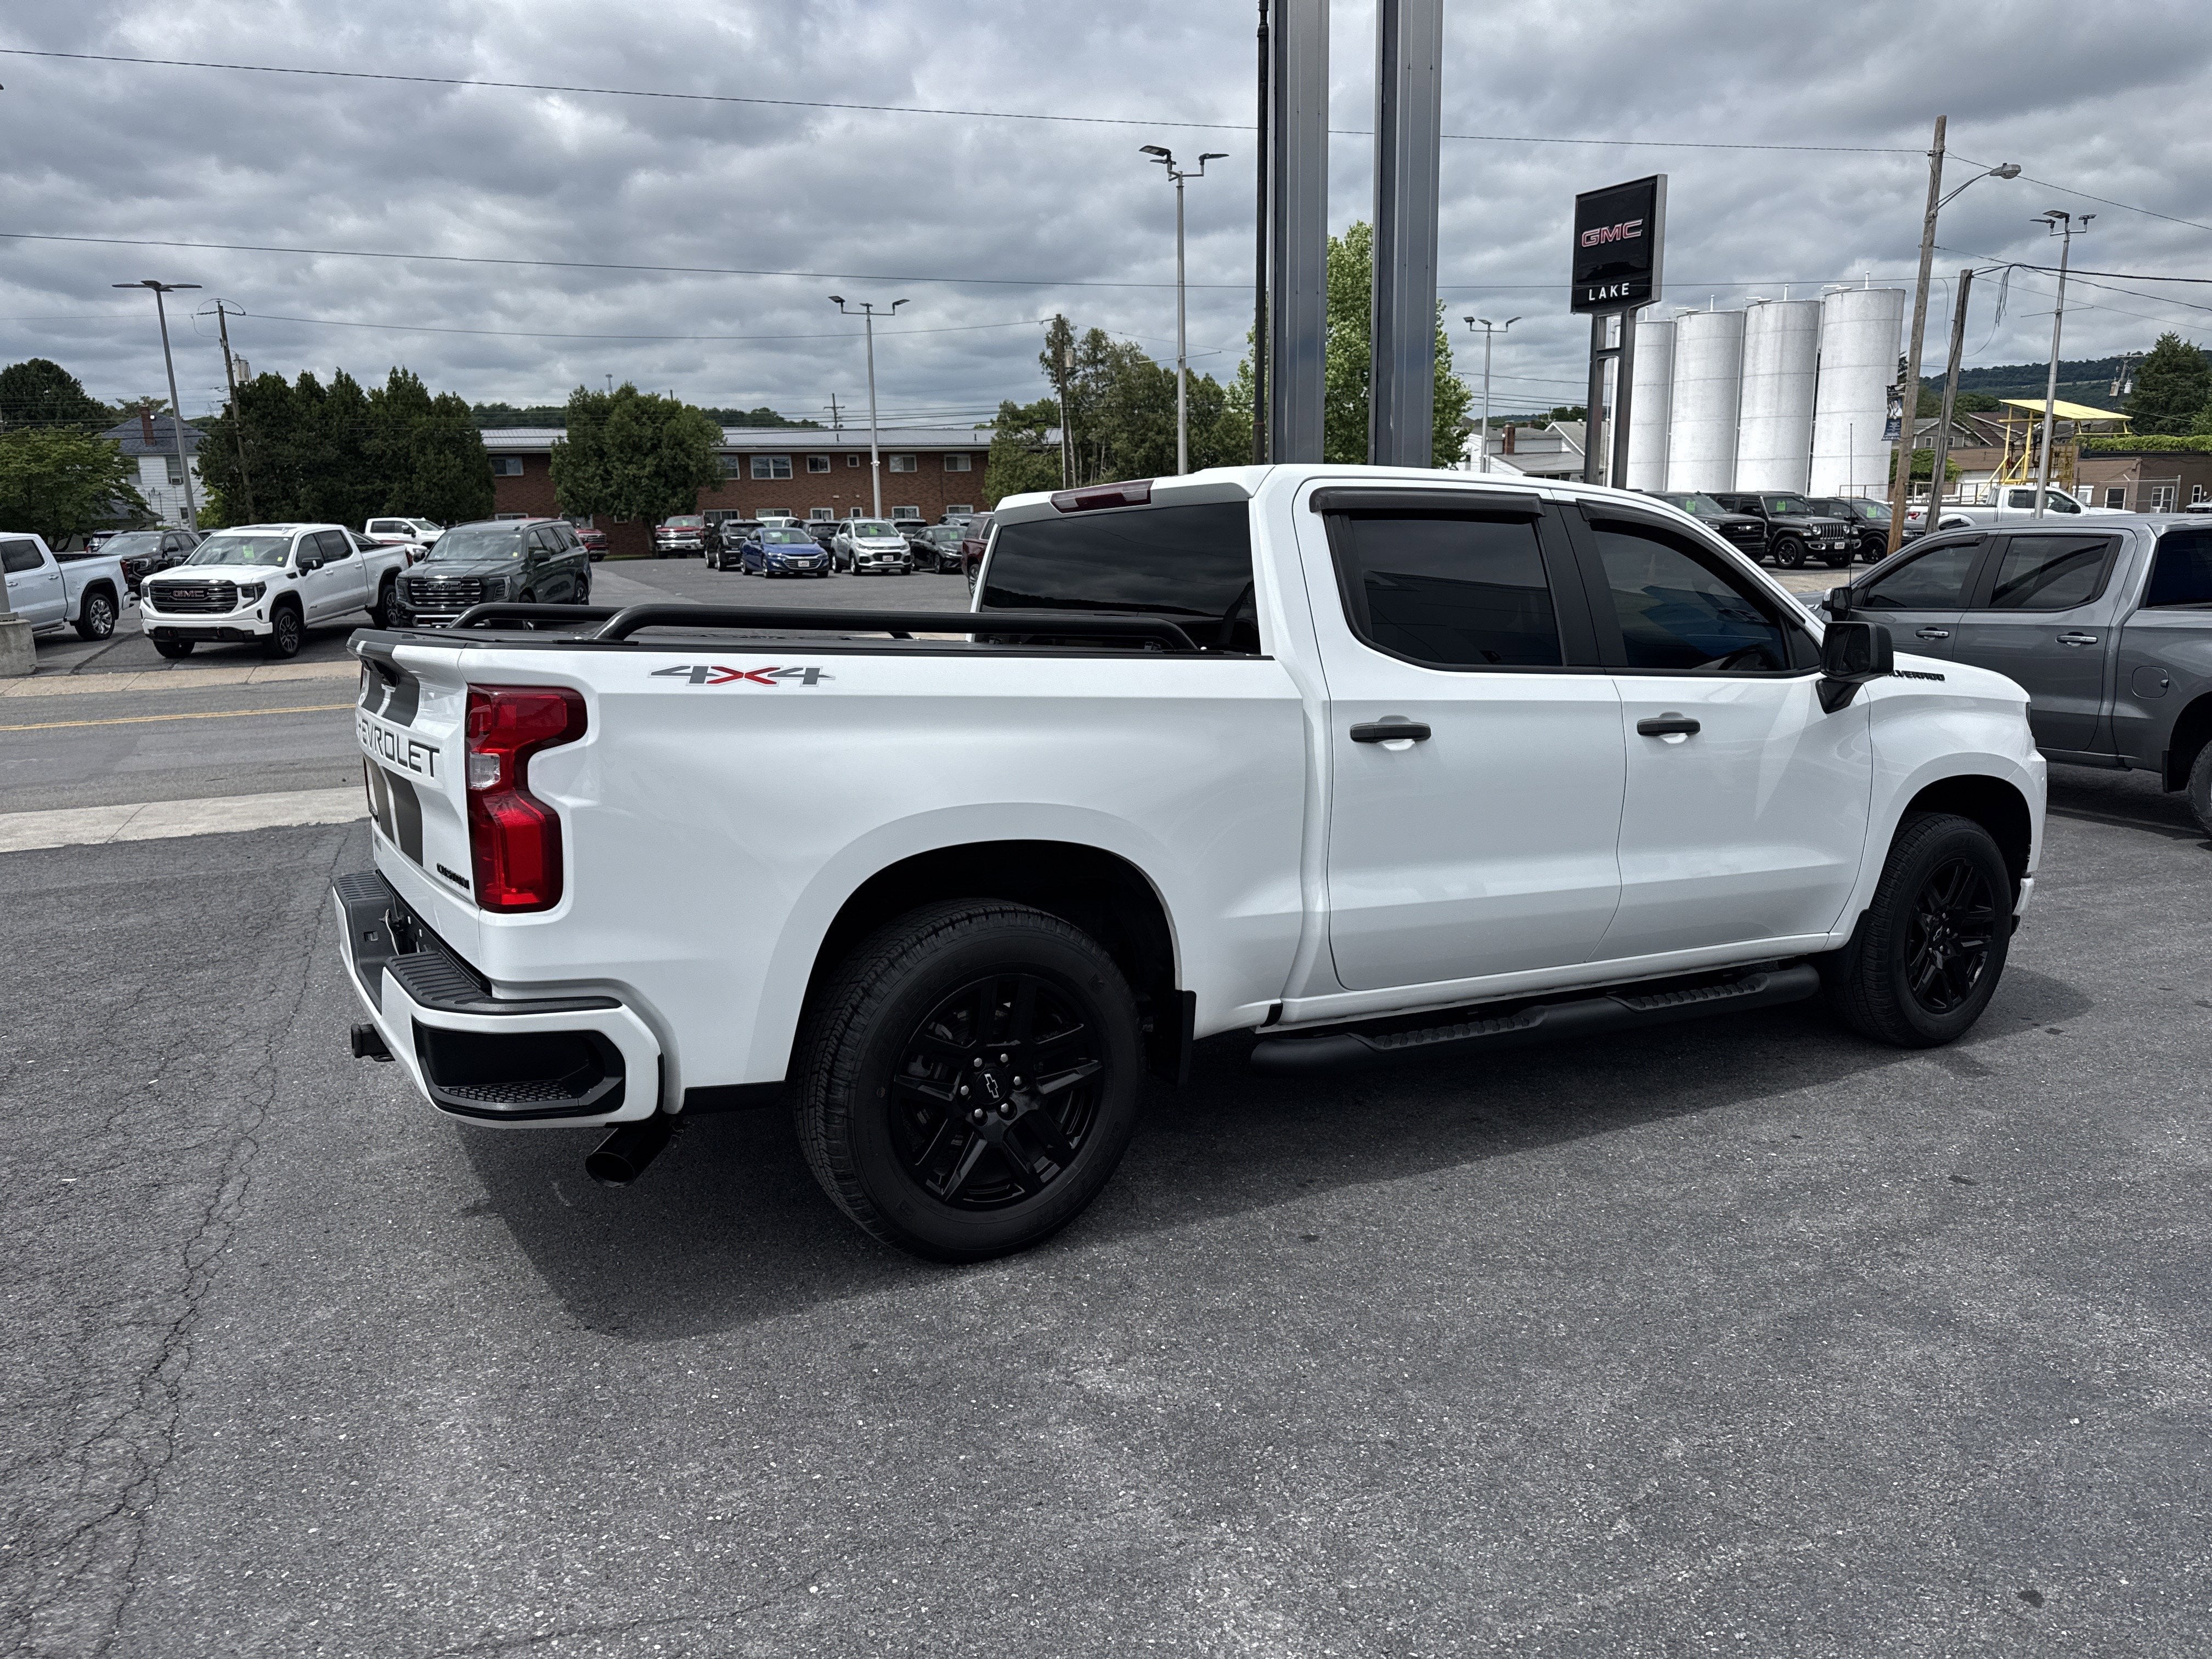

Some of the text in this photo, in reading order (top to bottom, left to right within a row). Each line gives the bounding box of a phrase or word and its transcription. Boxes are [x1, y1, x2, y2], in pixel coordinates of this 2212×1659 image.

[1582, 219, 1643, 247] GMC
[1589, 283, 1629, 301] LAKE
[1889, 669, 1945, 681] LVERADO
[356, 716, 440, 778] HEVROLET
